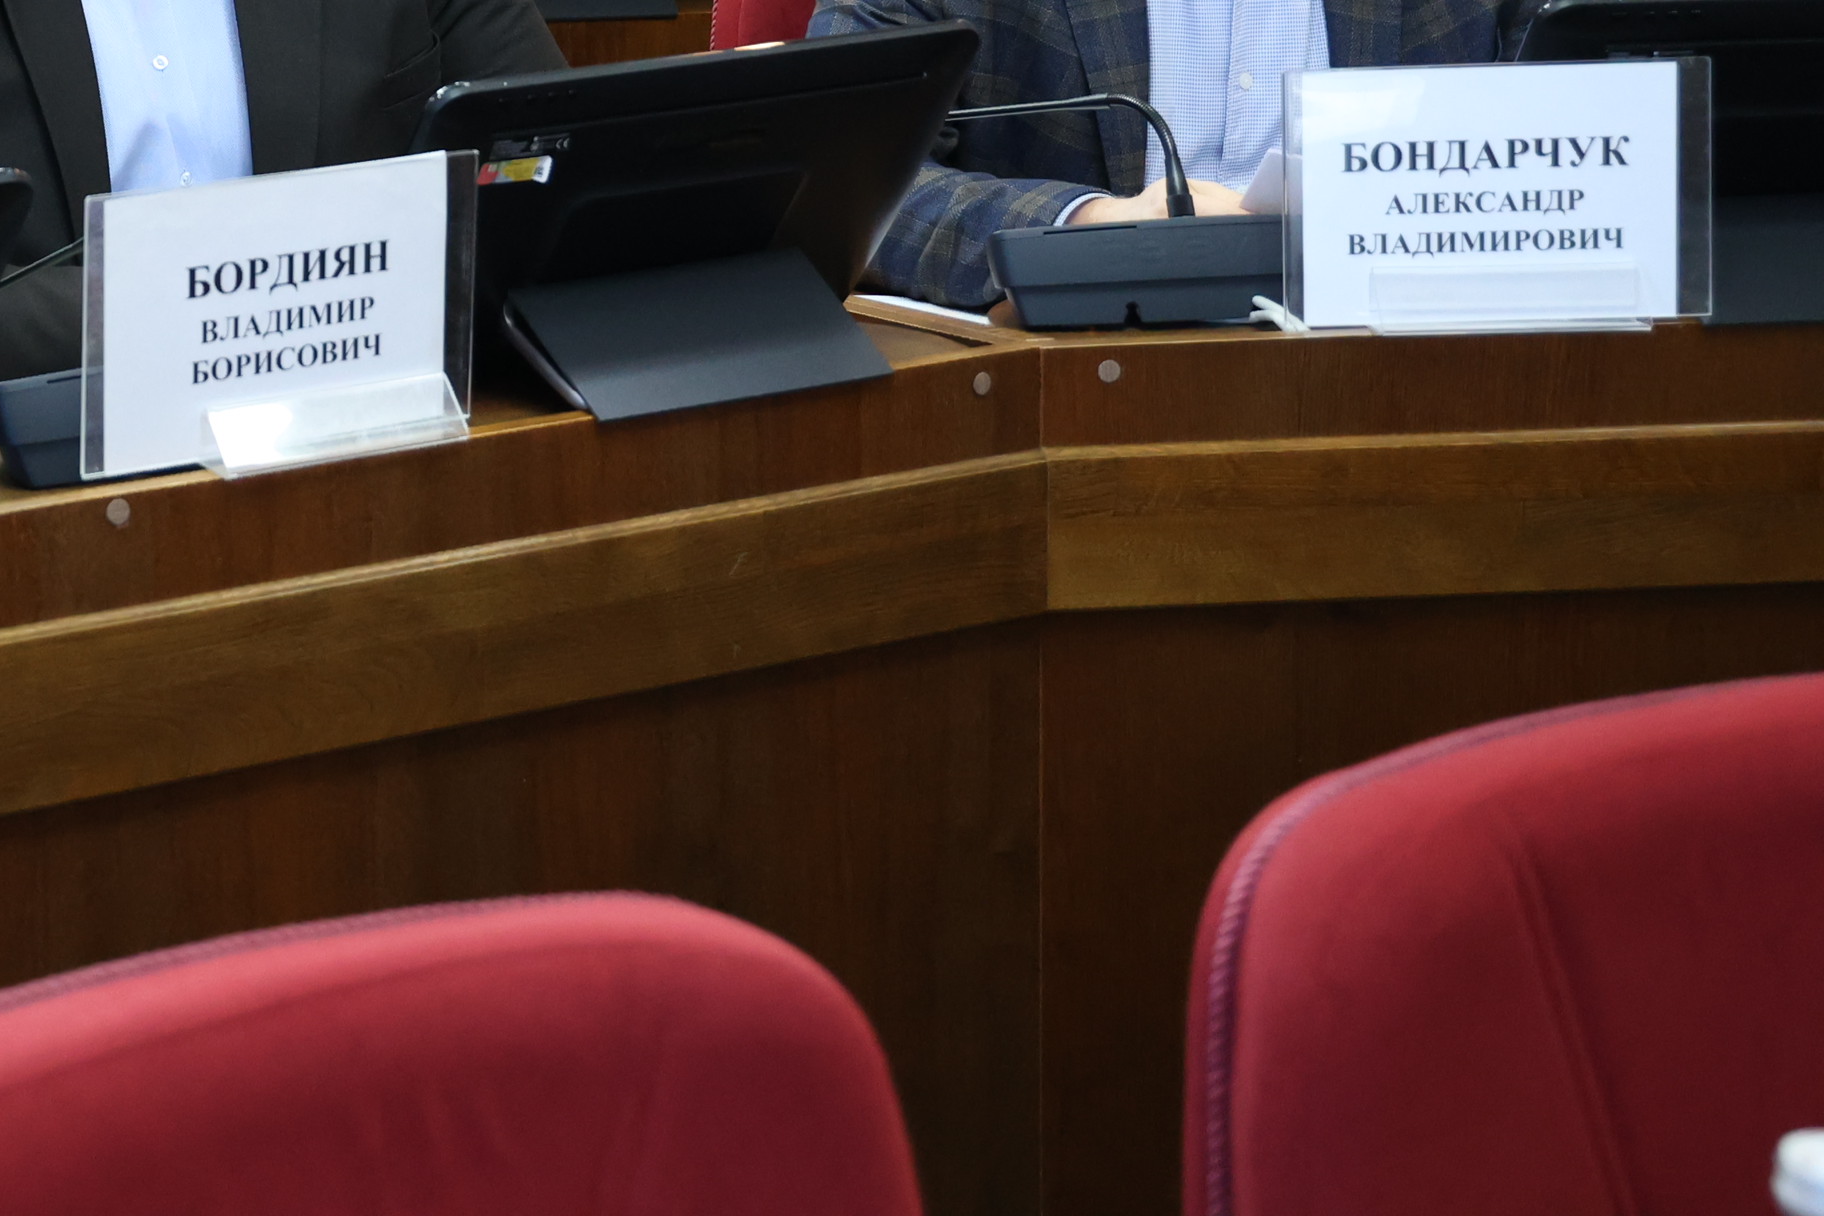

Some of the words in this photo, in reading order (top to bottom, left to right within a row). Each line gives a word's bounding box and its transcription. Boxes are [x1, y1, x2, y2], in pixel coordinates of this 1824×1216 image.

[1341, 135, 1631, 177] БОНДАРЧУК
[1385, 188, 1585, 216] АЛЕКСАНДР
[1347, 227, 1625, 259] ВЛАДИМИРОВИЧ
[186, 239, 390, 300] БОРДИЯН
[201, 296, 375, 344] ВЛАДИМИР
[191, 333, 382, 385] БОРИСОВИЧ
